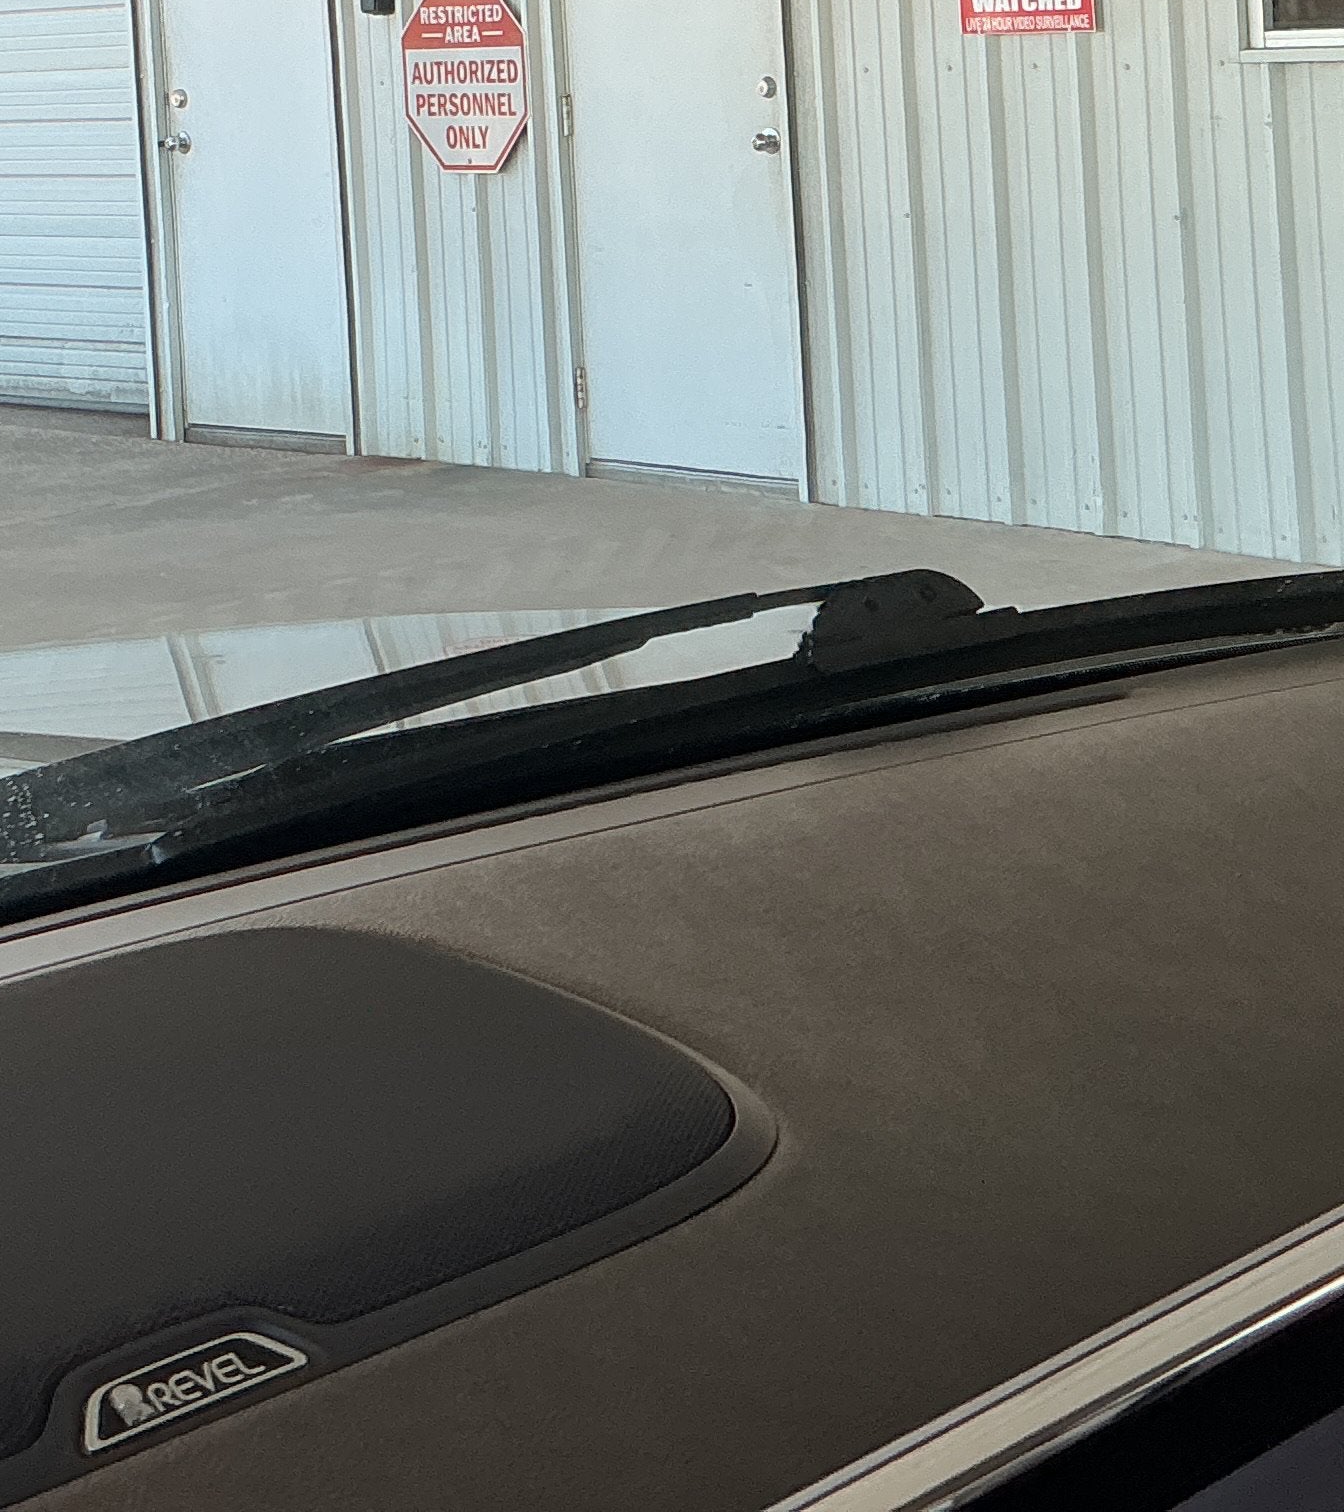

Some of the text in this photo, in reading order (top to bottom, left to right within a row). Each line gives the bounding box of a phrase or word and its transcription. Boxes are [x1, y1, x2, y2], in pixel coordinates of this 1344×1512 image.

[420, 4, 502, 24] RESTRICTED
[965, 14, 1090, 31] LIVE 24 HOUR VIDEO SURVEILLANCE
[445, 25, 480, 43] AREA
[412, 59, 518, 85] AUTHORIZED
[416, 93, 517, 117] PERSONNEL
[446, 125, 489, 149] ONLY
[146, 1352, 266, 1412] REVEL
